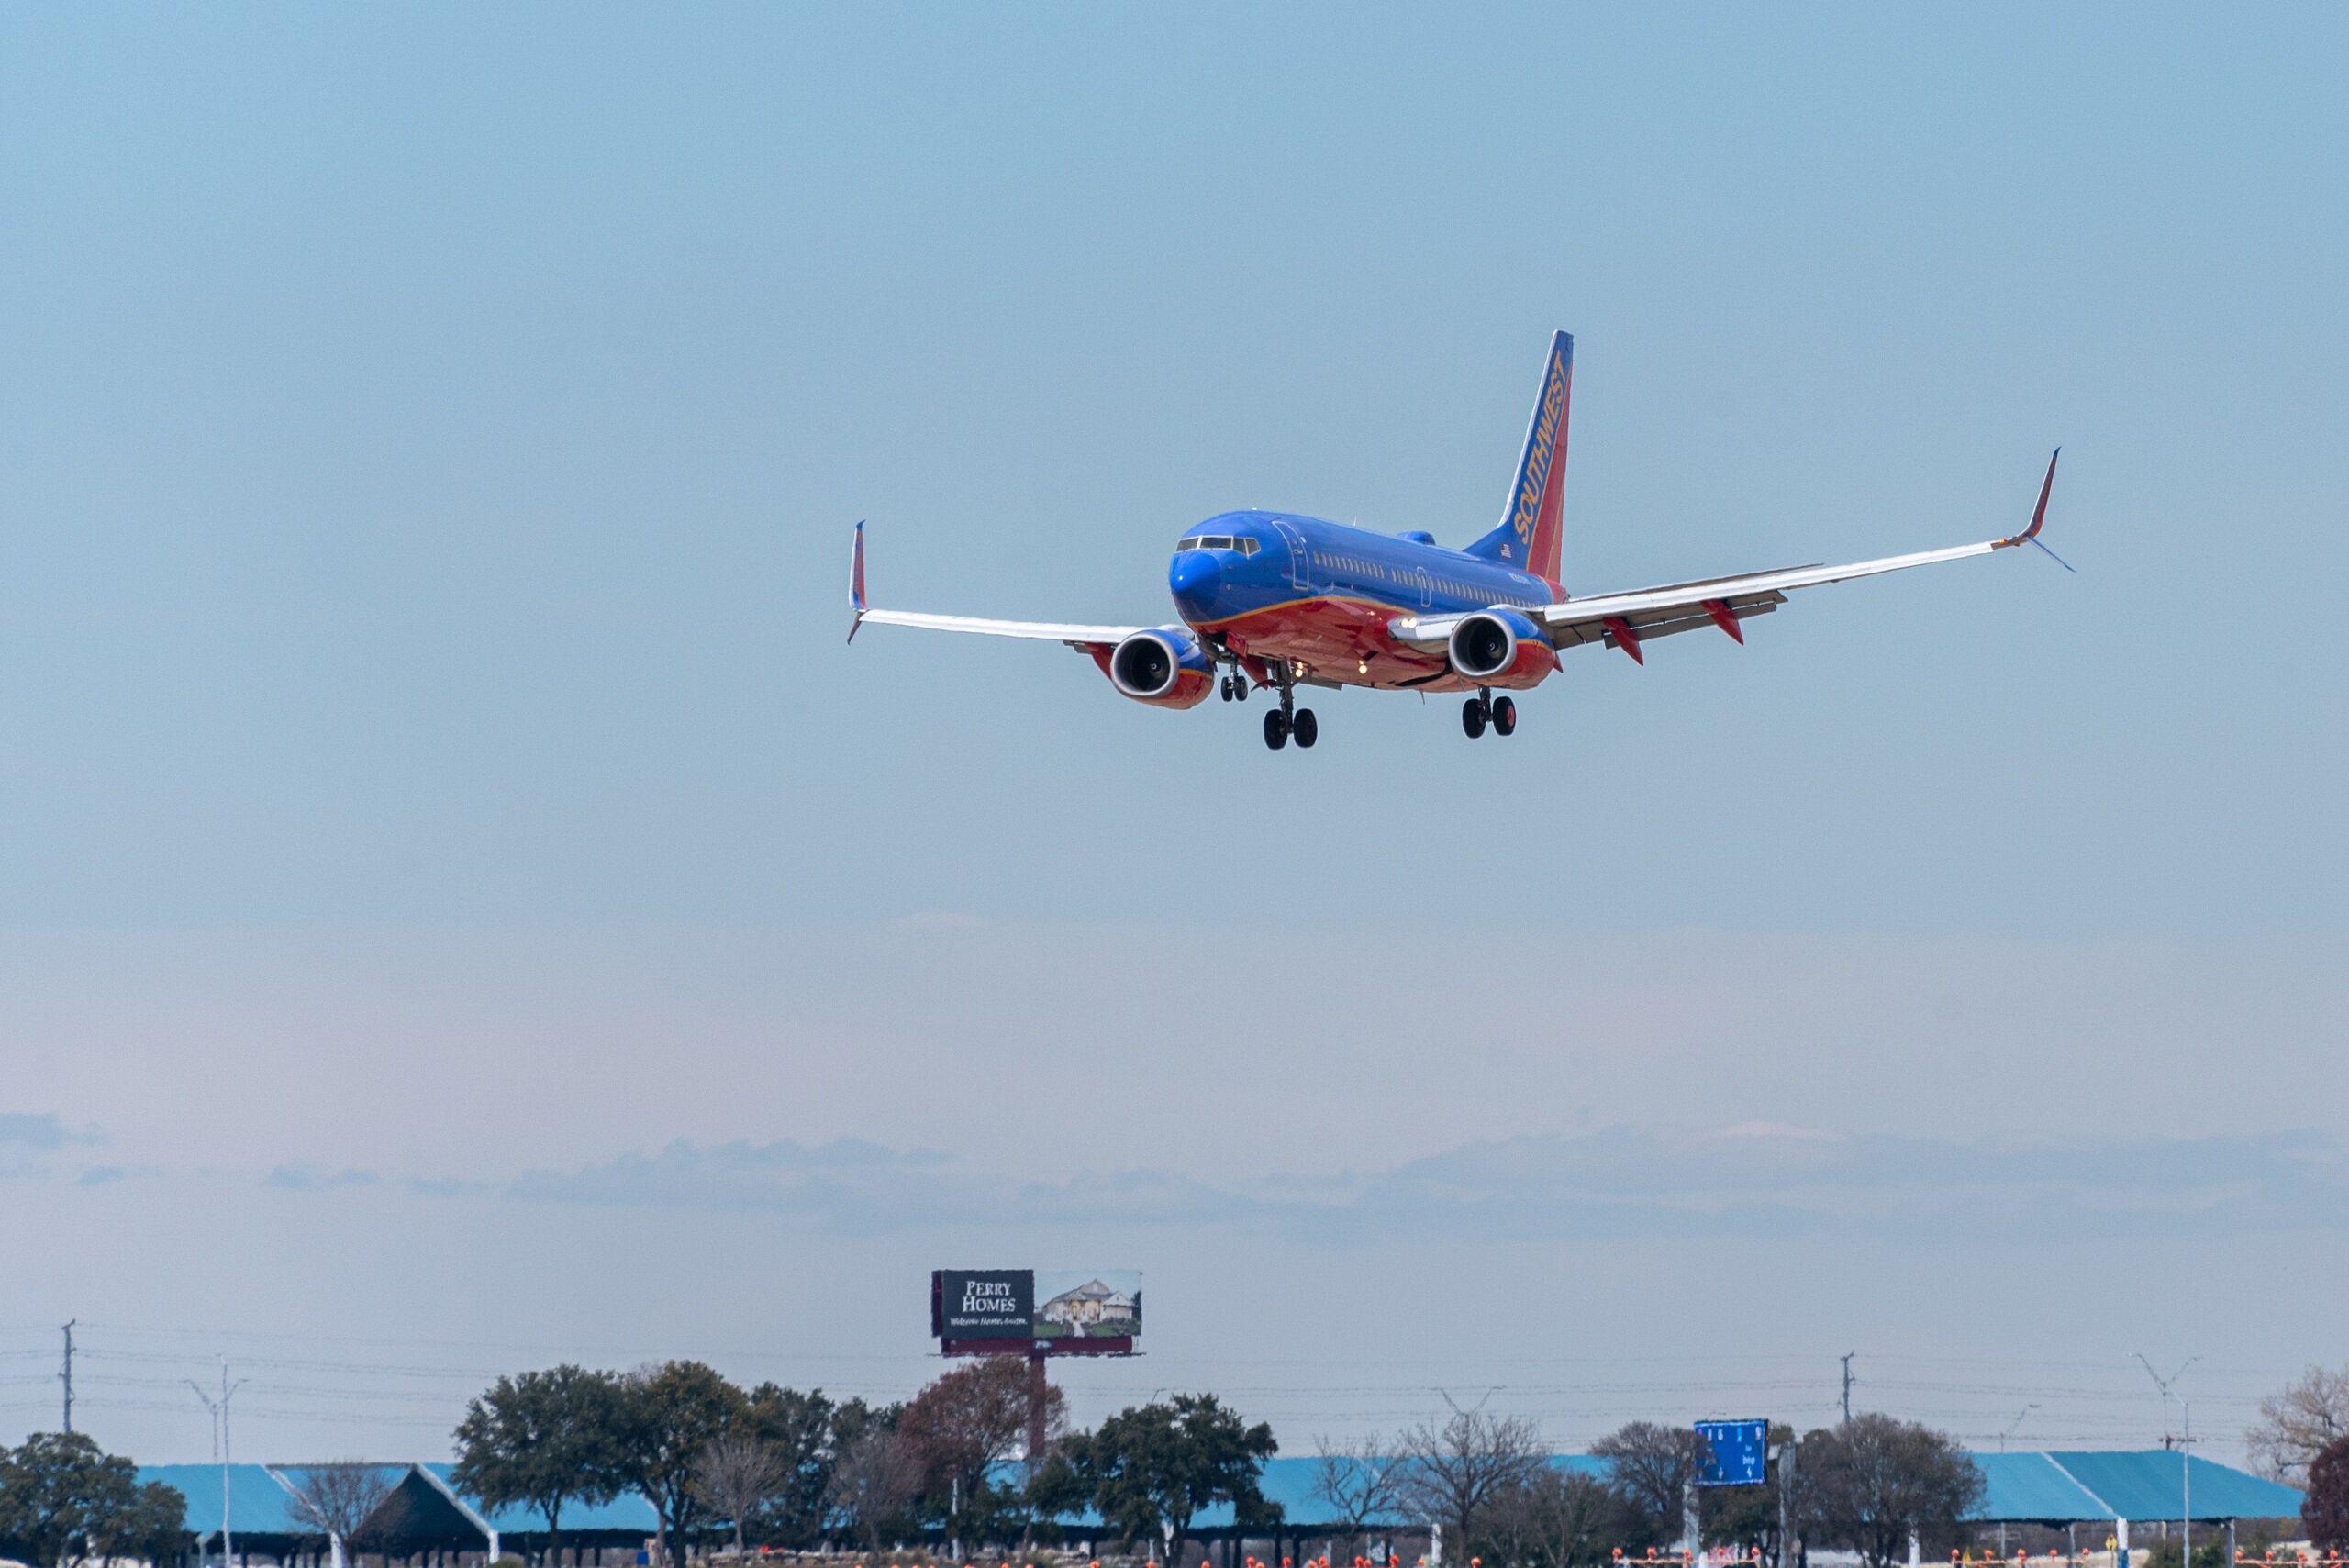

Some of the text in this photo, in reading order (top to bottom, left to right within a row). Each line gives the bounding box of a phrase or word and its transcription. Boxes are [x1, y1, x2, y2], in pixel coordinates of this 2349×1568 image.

[1514, 350, 1566, 544] SOUTHWEST
[966, 1281, 1011, 1296] PERRY
[962, 1296, 1016, 1312] HOMES
